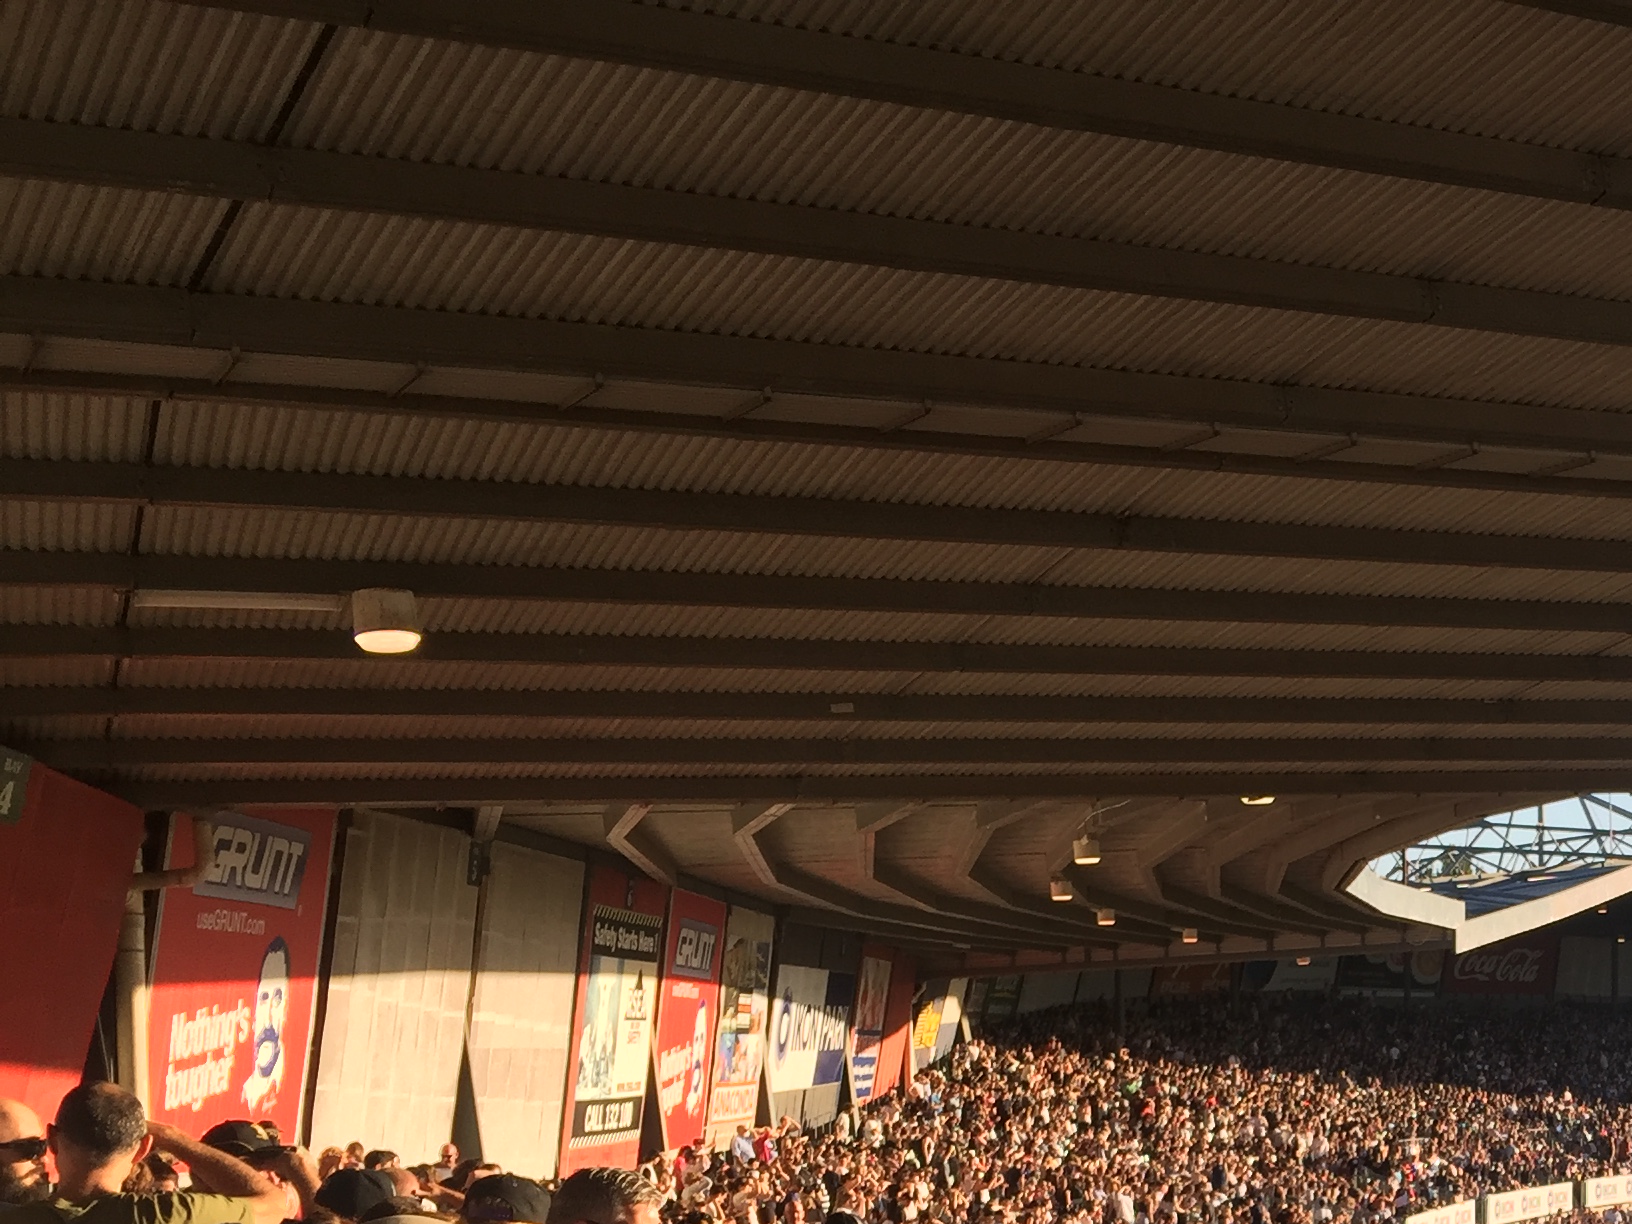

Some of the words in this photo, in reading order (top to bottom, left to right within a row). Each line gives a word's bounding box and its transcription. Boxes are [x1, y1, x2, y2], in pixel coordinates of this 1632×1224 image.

[203, 825, 305, 895] GRUNT
[196, 909, 266, 936] useGRUNT.com
[675, 927, 716, 970] GRUNT
[168, 999, 251, 1064] Nothing's
[165, 1052, 235, 1113] tougher
[584, 1103, 604, 1133] CALL
